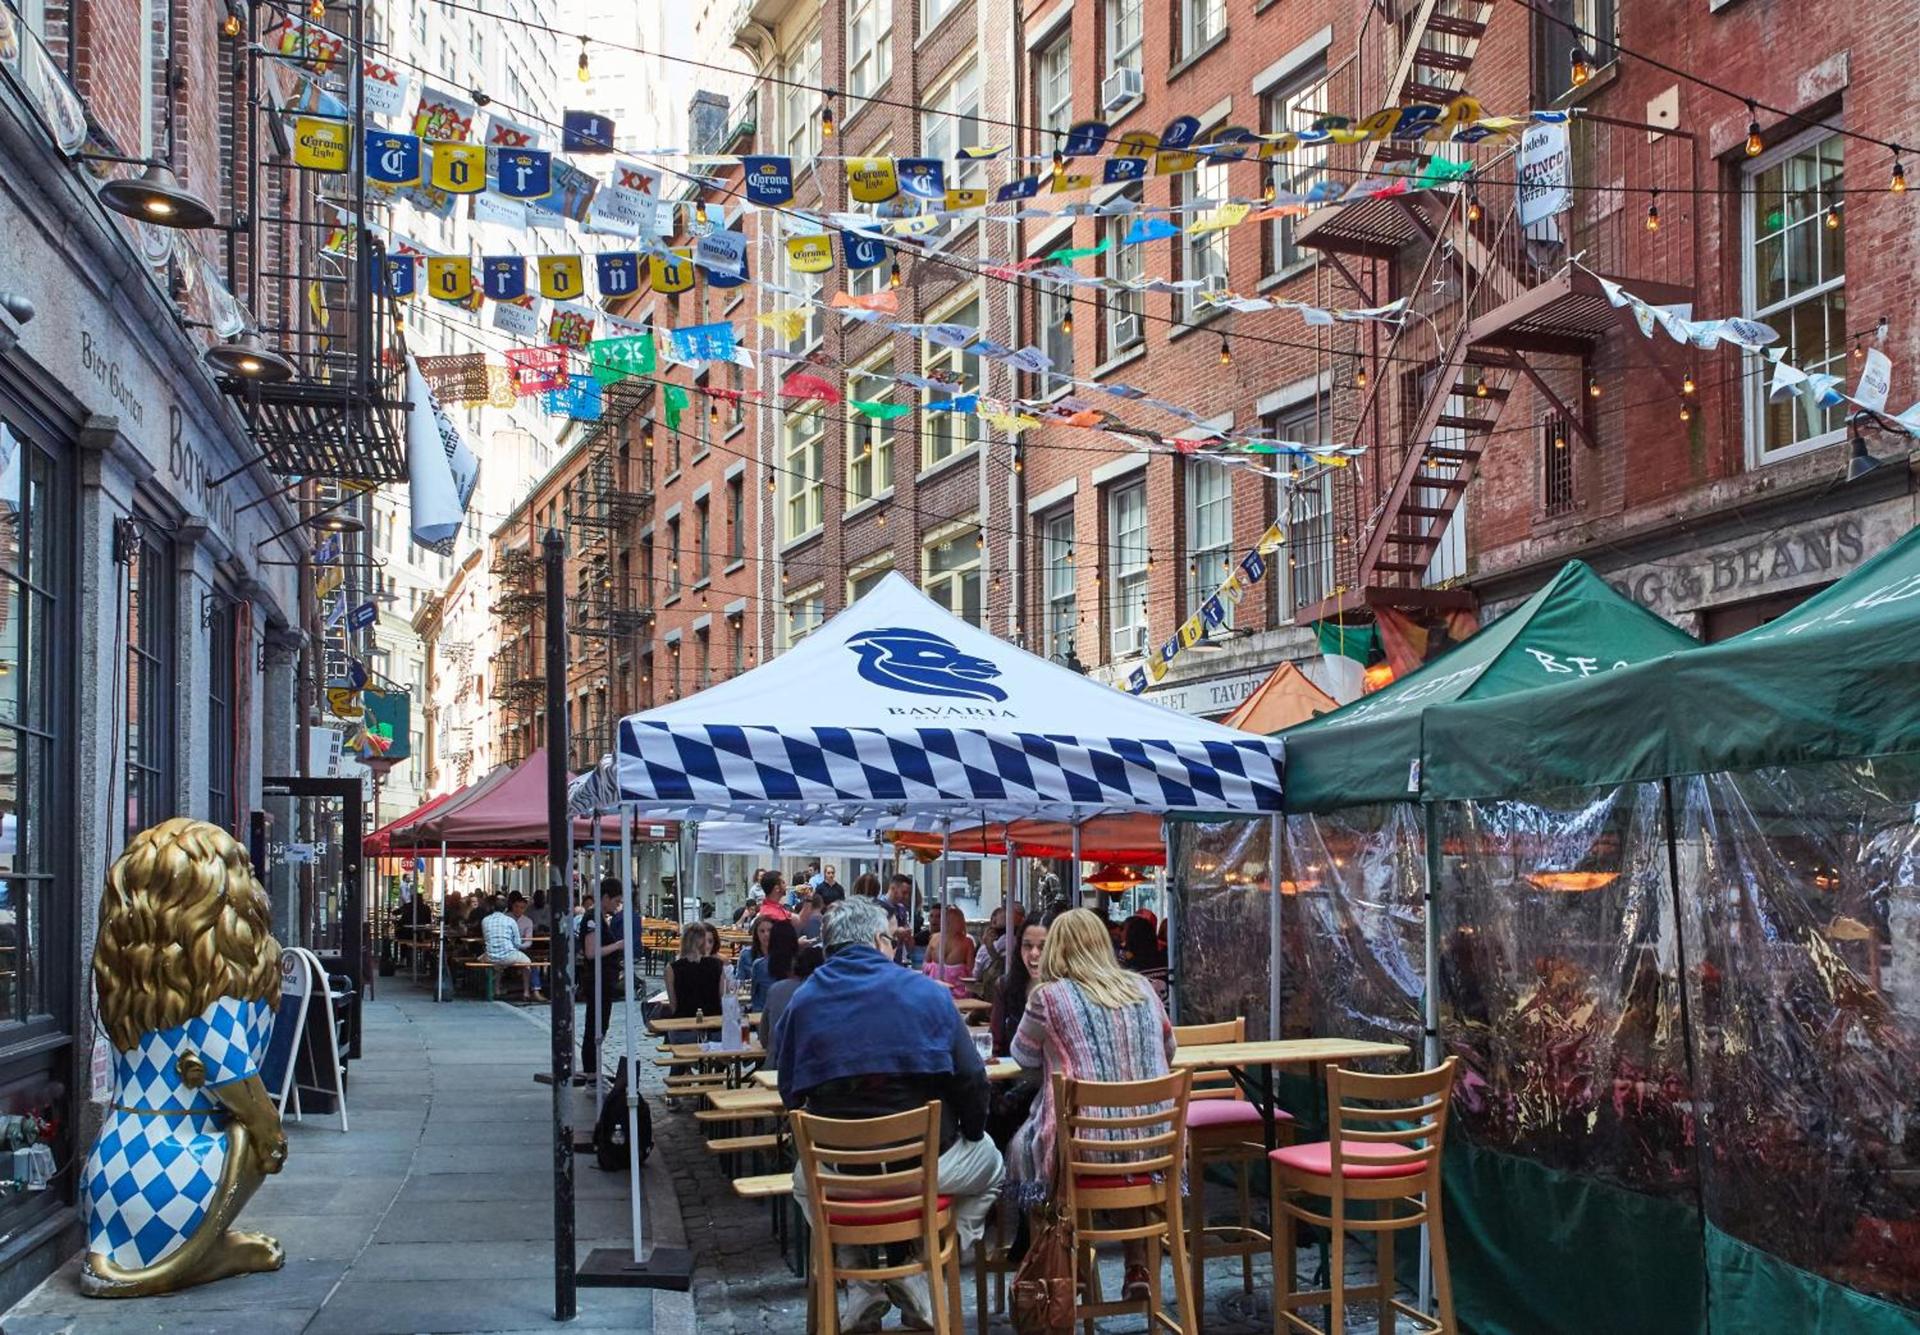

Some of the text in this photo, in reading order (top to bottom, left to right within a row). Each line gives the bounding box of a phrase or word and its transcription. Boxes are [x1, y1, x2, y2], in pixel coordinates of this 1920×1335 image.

[300, 134, 346, 152] Corona
[1523, 132, 1549, 154] odelo
[852, 168, 890, 182] Corona
[1523, 150, 1564, 182] CINCO
[618, 166, 654, 196] XX
[748, 172, 790, 188] Corona
[759, 186, 783, 195] Extra
[702, 242, 739, 260] Corona
[793, 248, 827, 260] Corona
[1707, 518, 1865, 594] BEANS
[886, 706, 1020, 719] BAVARIA
